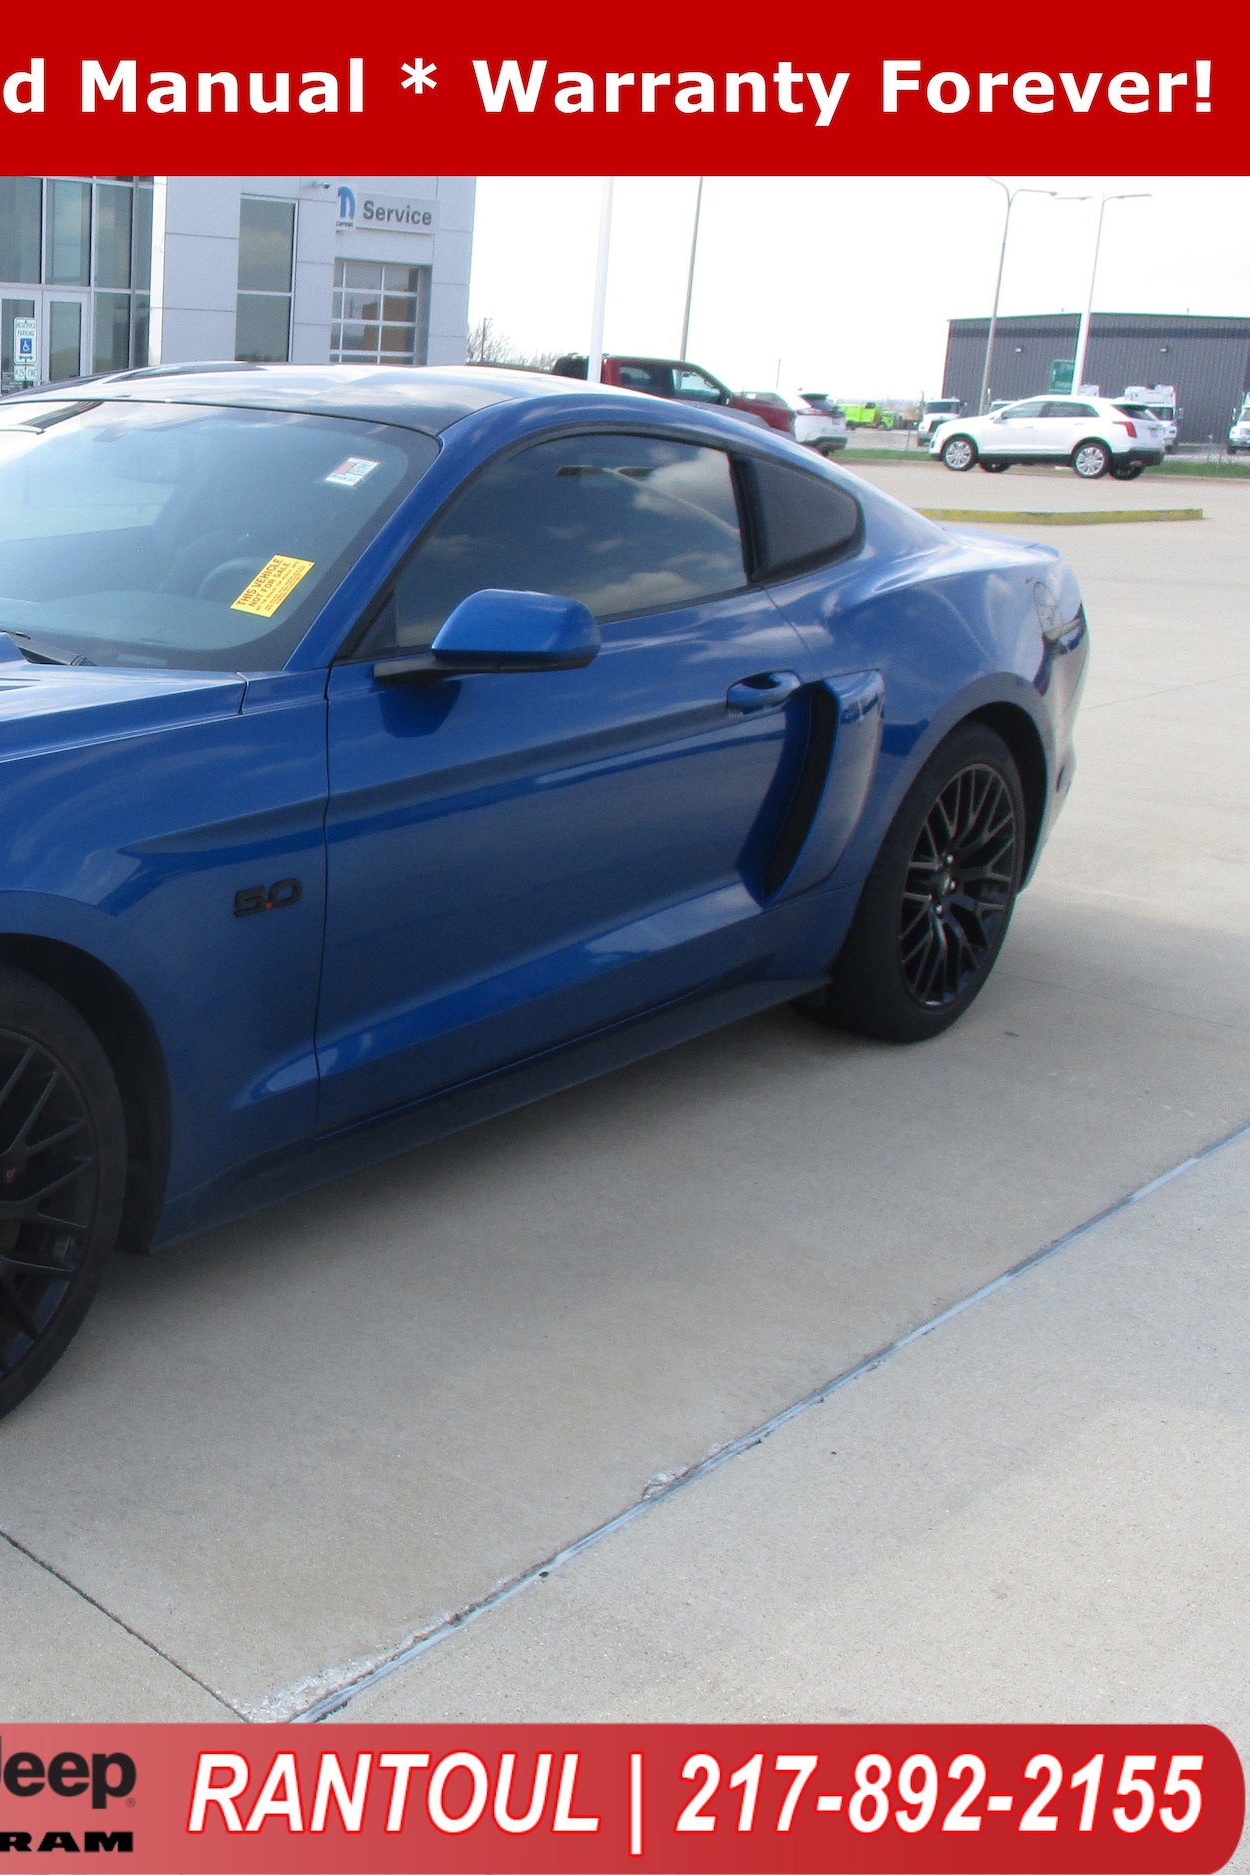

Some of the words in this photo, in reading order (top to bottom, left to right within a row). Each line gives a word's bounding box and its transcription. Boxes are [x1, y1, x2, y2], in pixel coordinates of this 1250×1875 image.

[363, 199, 433, 226] Service
[236, 589, 257, 606] THIS
[251, 557, 283, 587] VEHICLE
[248, 593, 263, 607] NOT
[261, 579, 276, 592] FOR
[273, 562, 291, 578] SALE
[233, 878, 302, 918] 5.0
